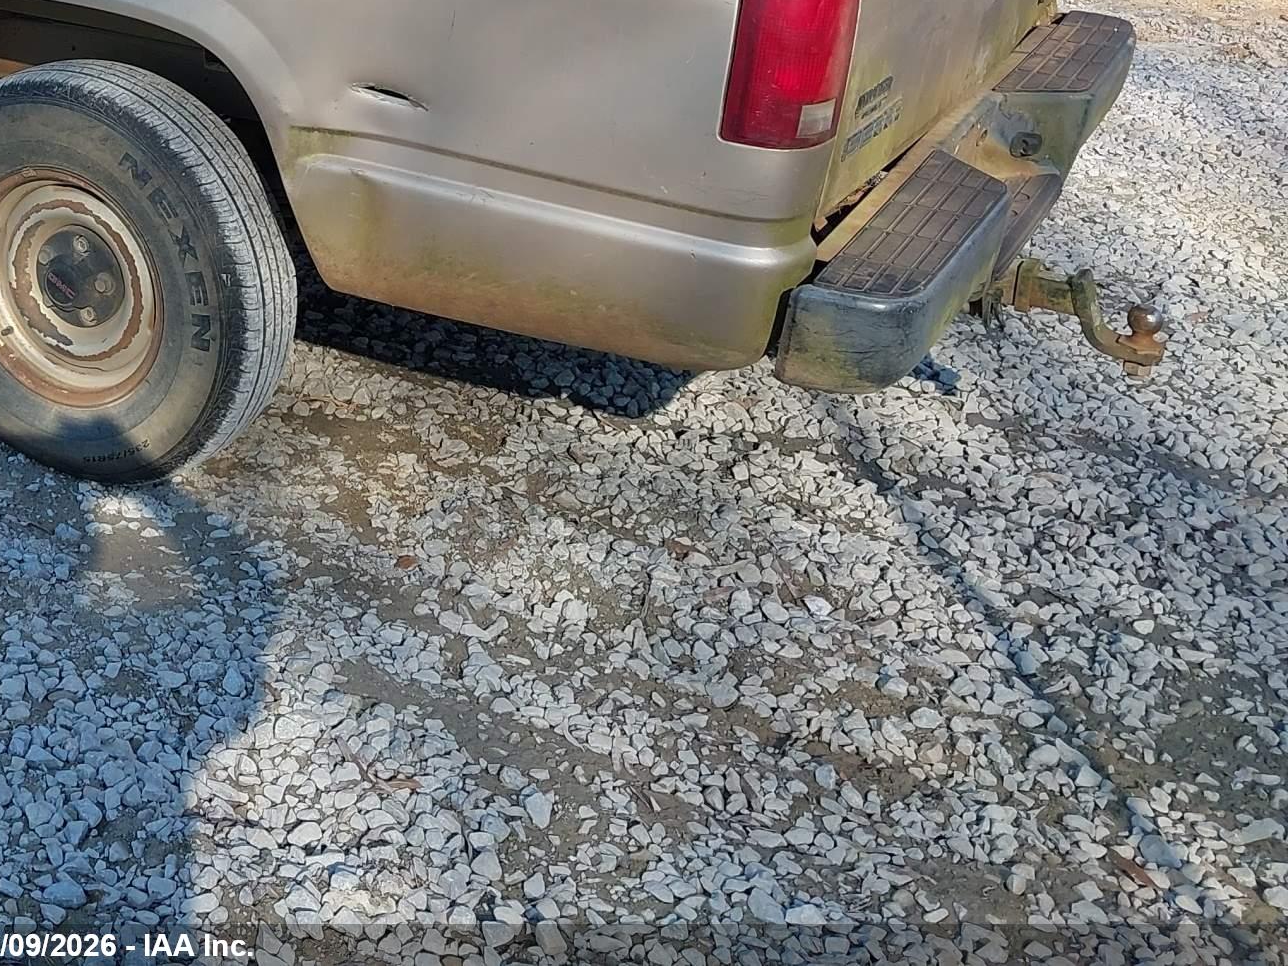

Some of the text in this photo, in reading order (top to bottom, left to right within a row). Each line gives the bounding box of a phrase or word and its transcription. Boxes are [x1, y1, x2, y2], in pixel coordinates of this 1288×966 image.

[118, 152, 212, 352] NEXEN
[48, 272, 76, 299] GMC
[82, 439, 150, 463] 235/75R15
